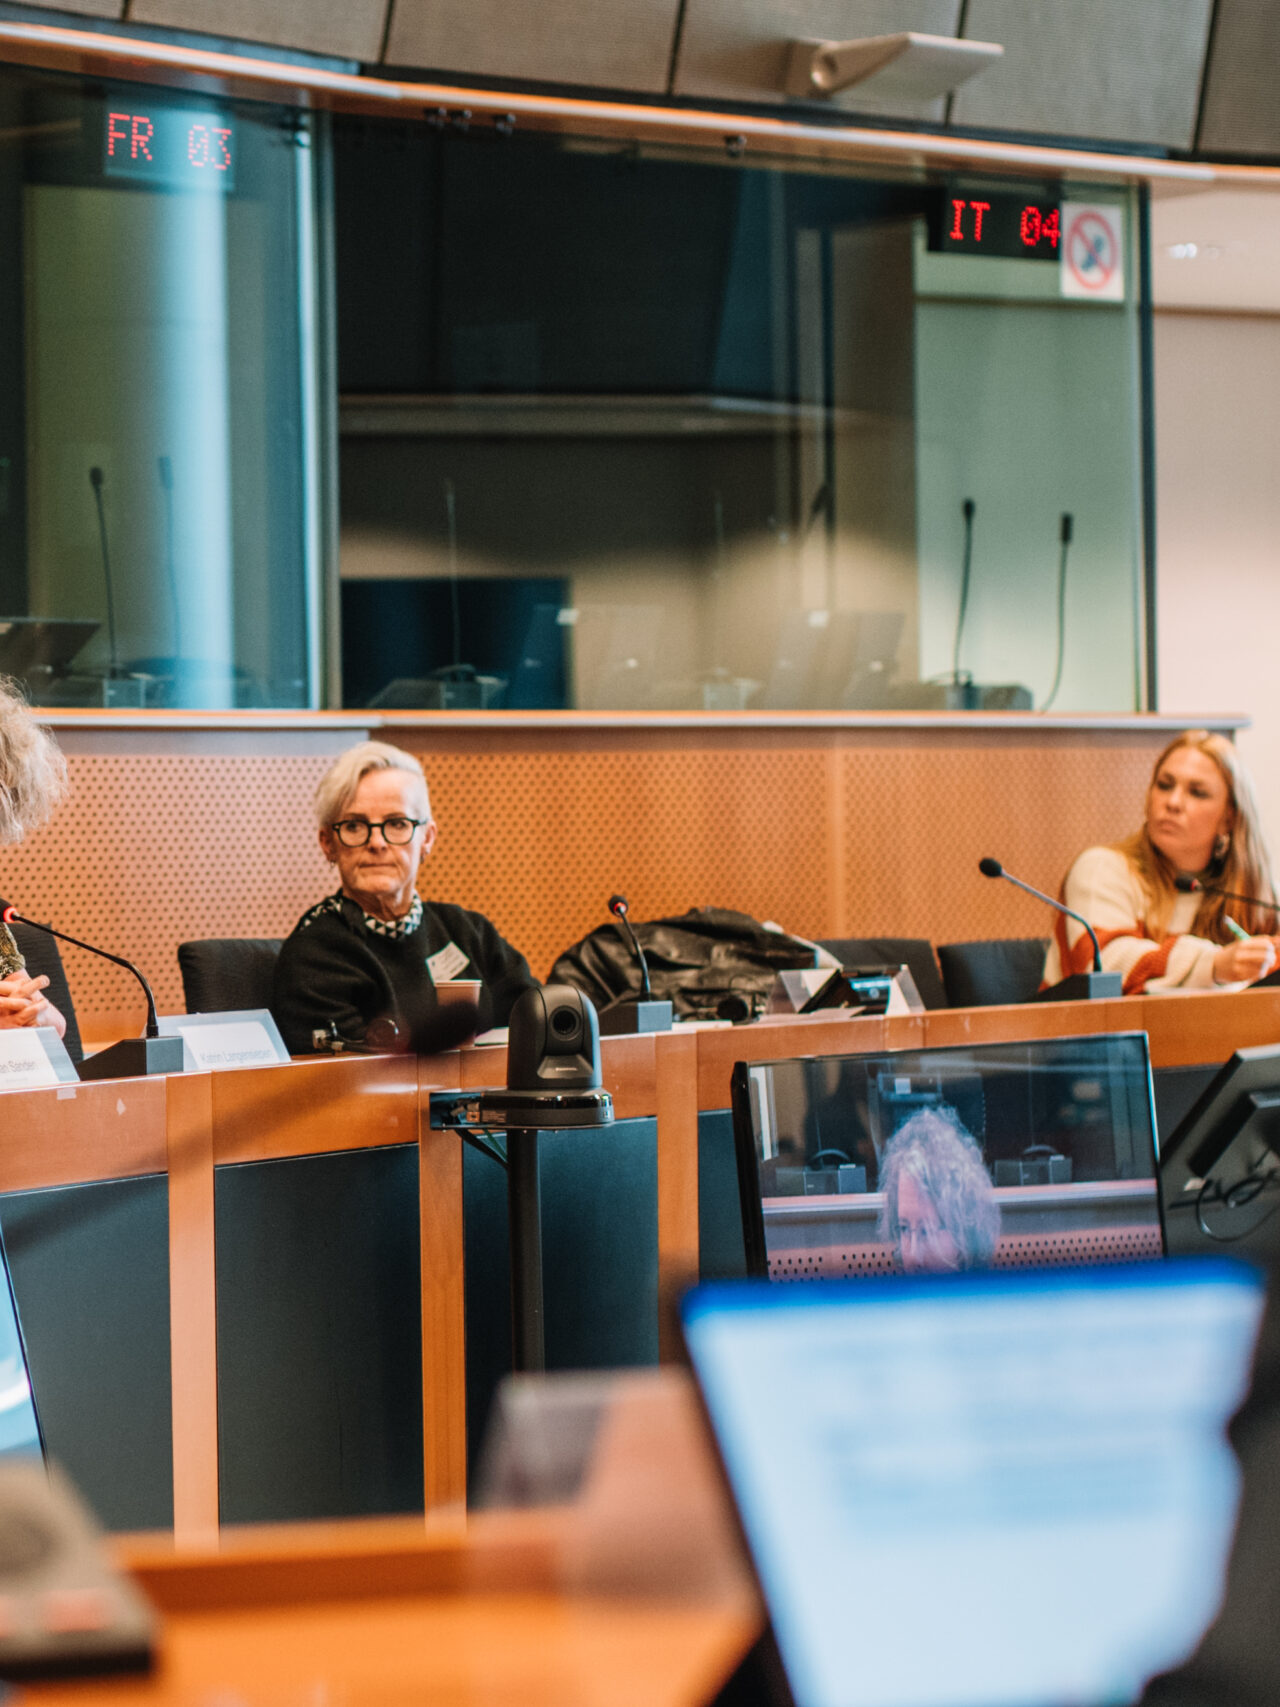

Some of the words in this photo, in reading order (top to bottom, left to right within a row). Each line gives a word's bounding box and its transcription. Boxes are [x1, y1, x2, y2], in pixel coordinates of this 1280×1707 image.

[108, 112, 153, 161] FR
[188, 124, 232, 170] 03
[950, 199, 991, 242] IT
[1020, 206, 1061, 248] 04
